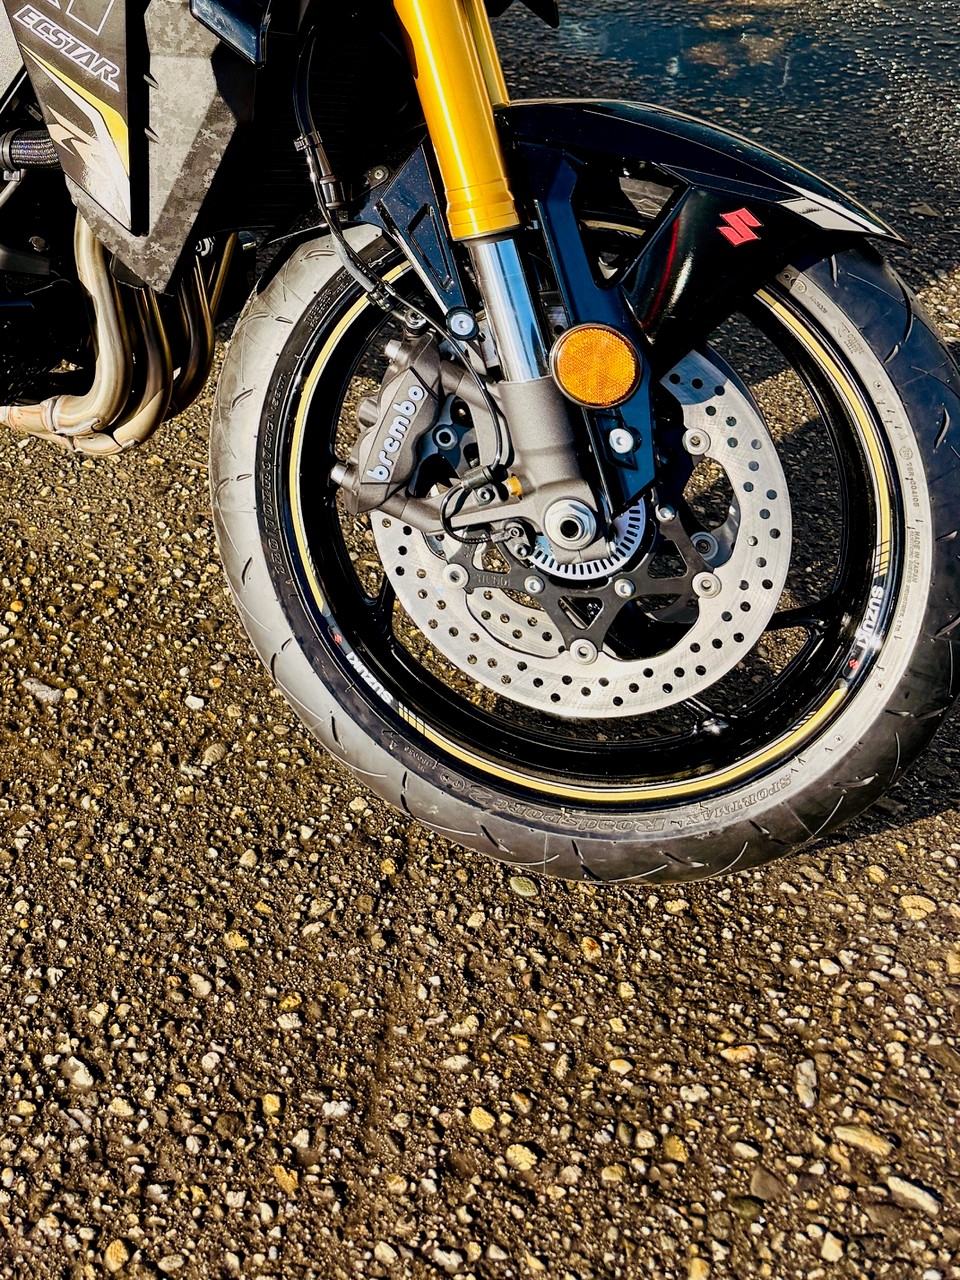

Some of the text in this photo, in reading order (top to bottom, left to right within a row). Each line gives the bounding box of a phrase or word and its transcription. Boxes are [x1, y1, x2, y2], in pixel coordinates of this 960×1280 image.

[13, 3, 121, 93] ECSTAR
[366, 384, 424, 481] brembo
[856, 585, 884, 648] SUZUKI
[346, 652, 394, 704] SUZUKI
